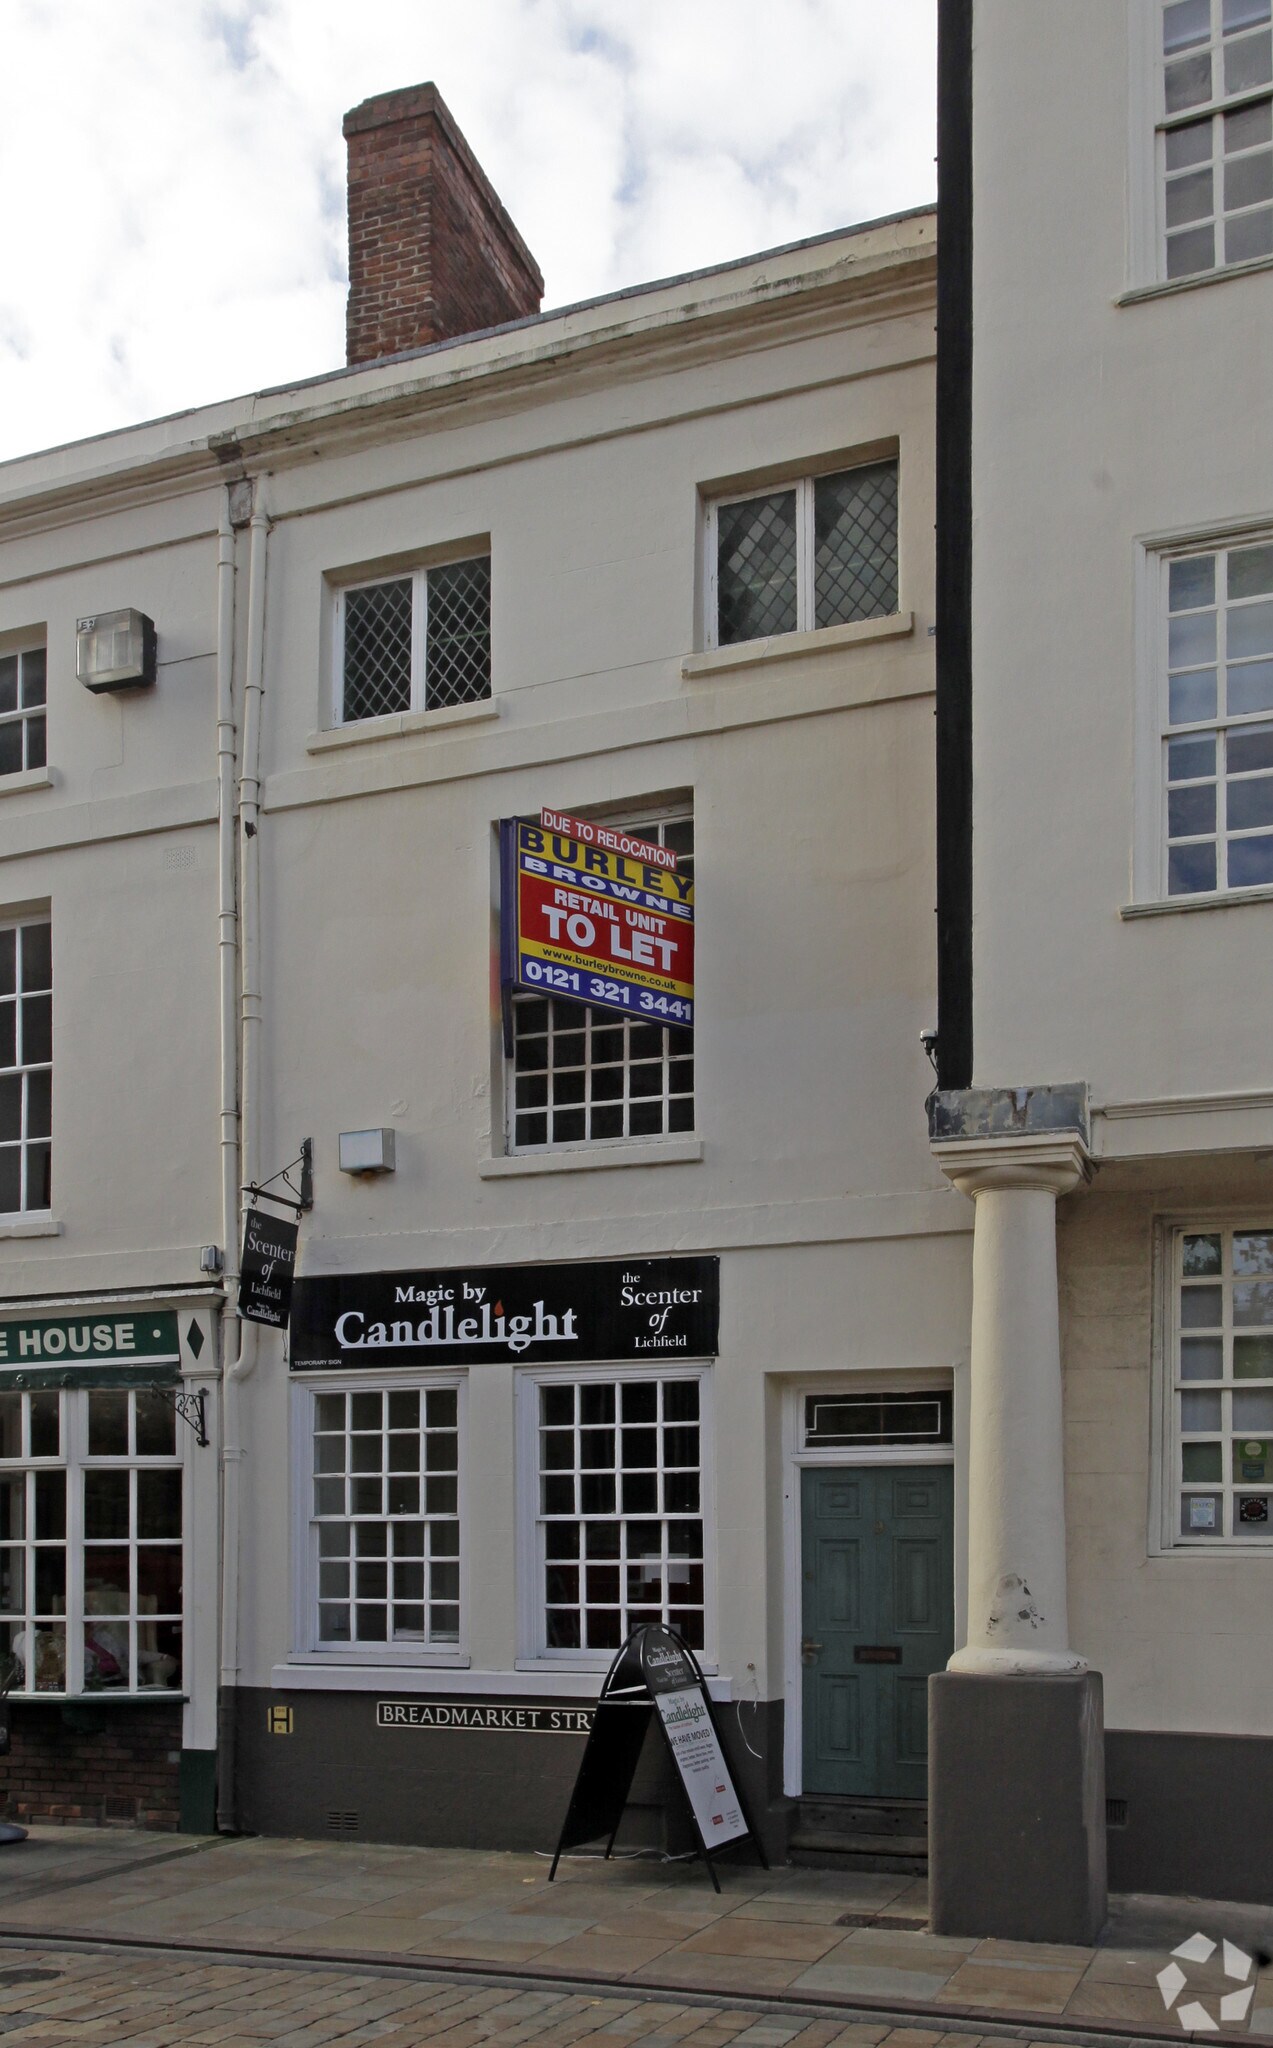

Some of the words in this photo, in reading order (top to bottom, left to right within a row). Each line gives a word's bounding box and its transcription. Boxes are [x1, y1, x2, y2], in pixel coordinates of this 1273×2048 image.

[543, 810, 571, 834] DUE
[575, 821, 594, 841] TO
[597, 829, 675, 869] RELOCATION
[519, 825, 694, 901] BURLEY
[524, 855, 692, 918] BROWNE
[554, 888, 620, 922] RETAIL
[625, 909, 667, 935] UNIT
[541, 904, 596, 948] TO
[610, 924, 678, 972] LET
[542, 947, 677, 991] www.burleybrowne.co.uk
[525, 961, 580, 991] 0121
[590, 978, 630, 1005] 321
[639, 991, 692, 1021] 3441
[247, 1231, 294, 1262] Scenter
[261, 1259, 277, 1284] of
[622, 1272, 641, 1283] the
[250, 1281, 282, 1300] Lichfield
[394, 1284, 455, 1306] Magic
[462, 1282, 487, 1304] by
[620, 1286, 702, 1307] Scenter
[334, 1299, 579, 1354] Candlelight
[648, 1306, 673, 1335] of
[19, 1323, 136, 1356] HOUSE
[634, 1335, 687, 1348] Lichfield
[383, 1705, 541, 1728] BREADMARKET
[550, 1711, 595, 1729] STR
[678, 1732, 692, 1744] HAVE
[691, 1728, 711, 1741] MOVED
